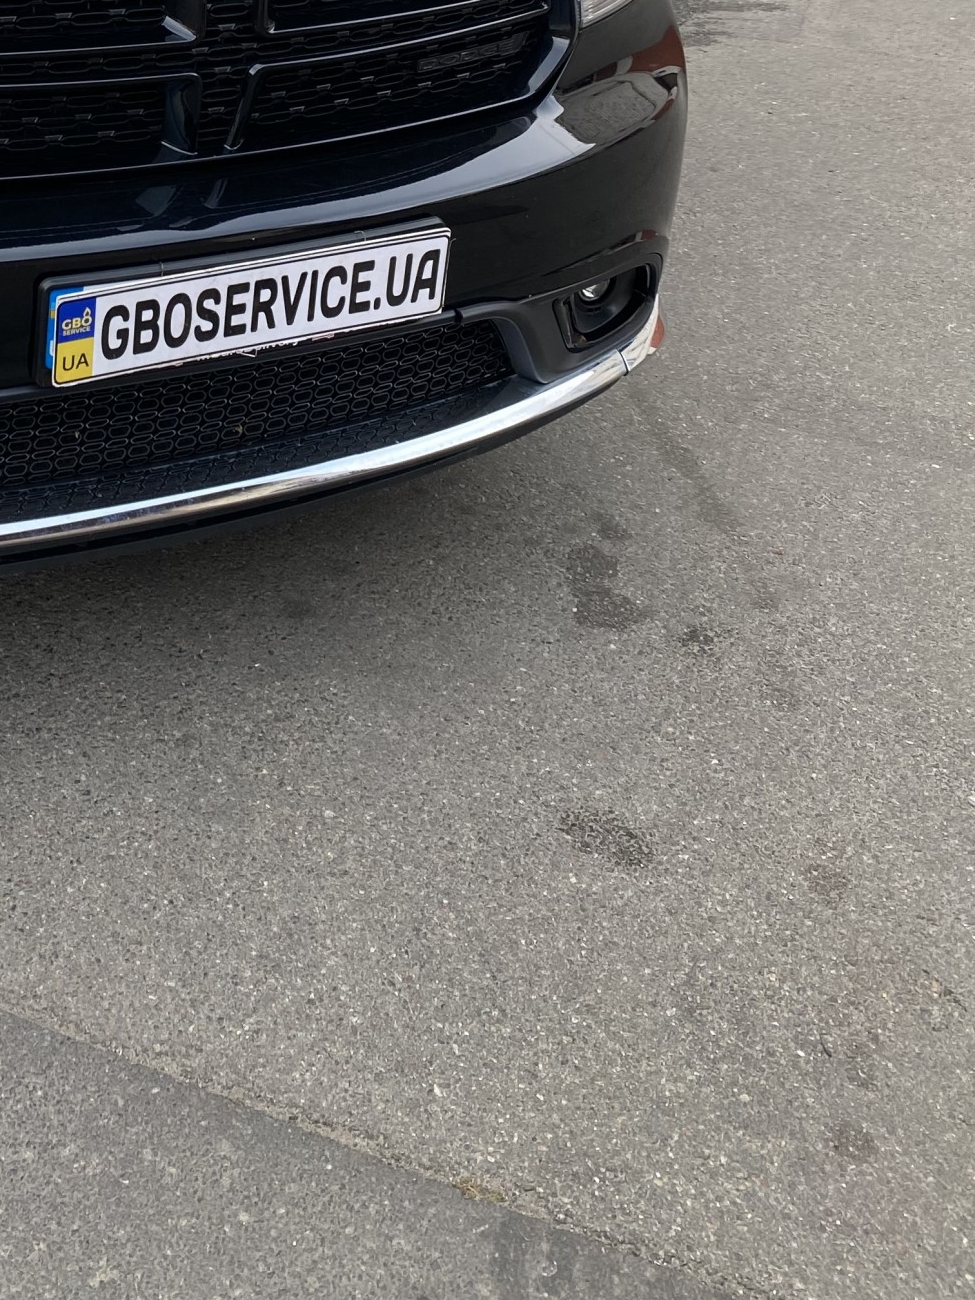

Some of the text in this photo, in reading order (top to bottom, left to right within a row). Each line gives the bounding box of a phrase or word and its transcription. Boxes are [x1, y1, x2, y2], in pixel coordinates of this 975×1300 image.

[101, 248, 440, 360] GBOSERVICE.UA
[62, 315, 92, 330] GBO
[63, 326, 91, 336] SERVICE
[63, 353, 90, 371] UA
